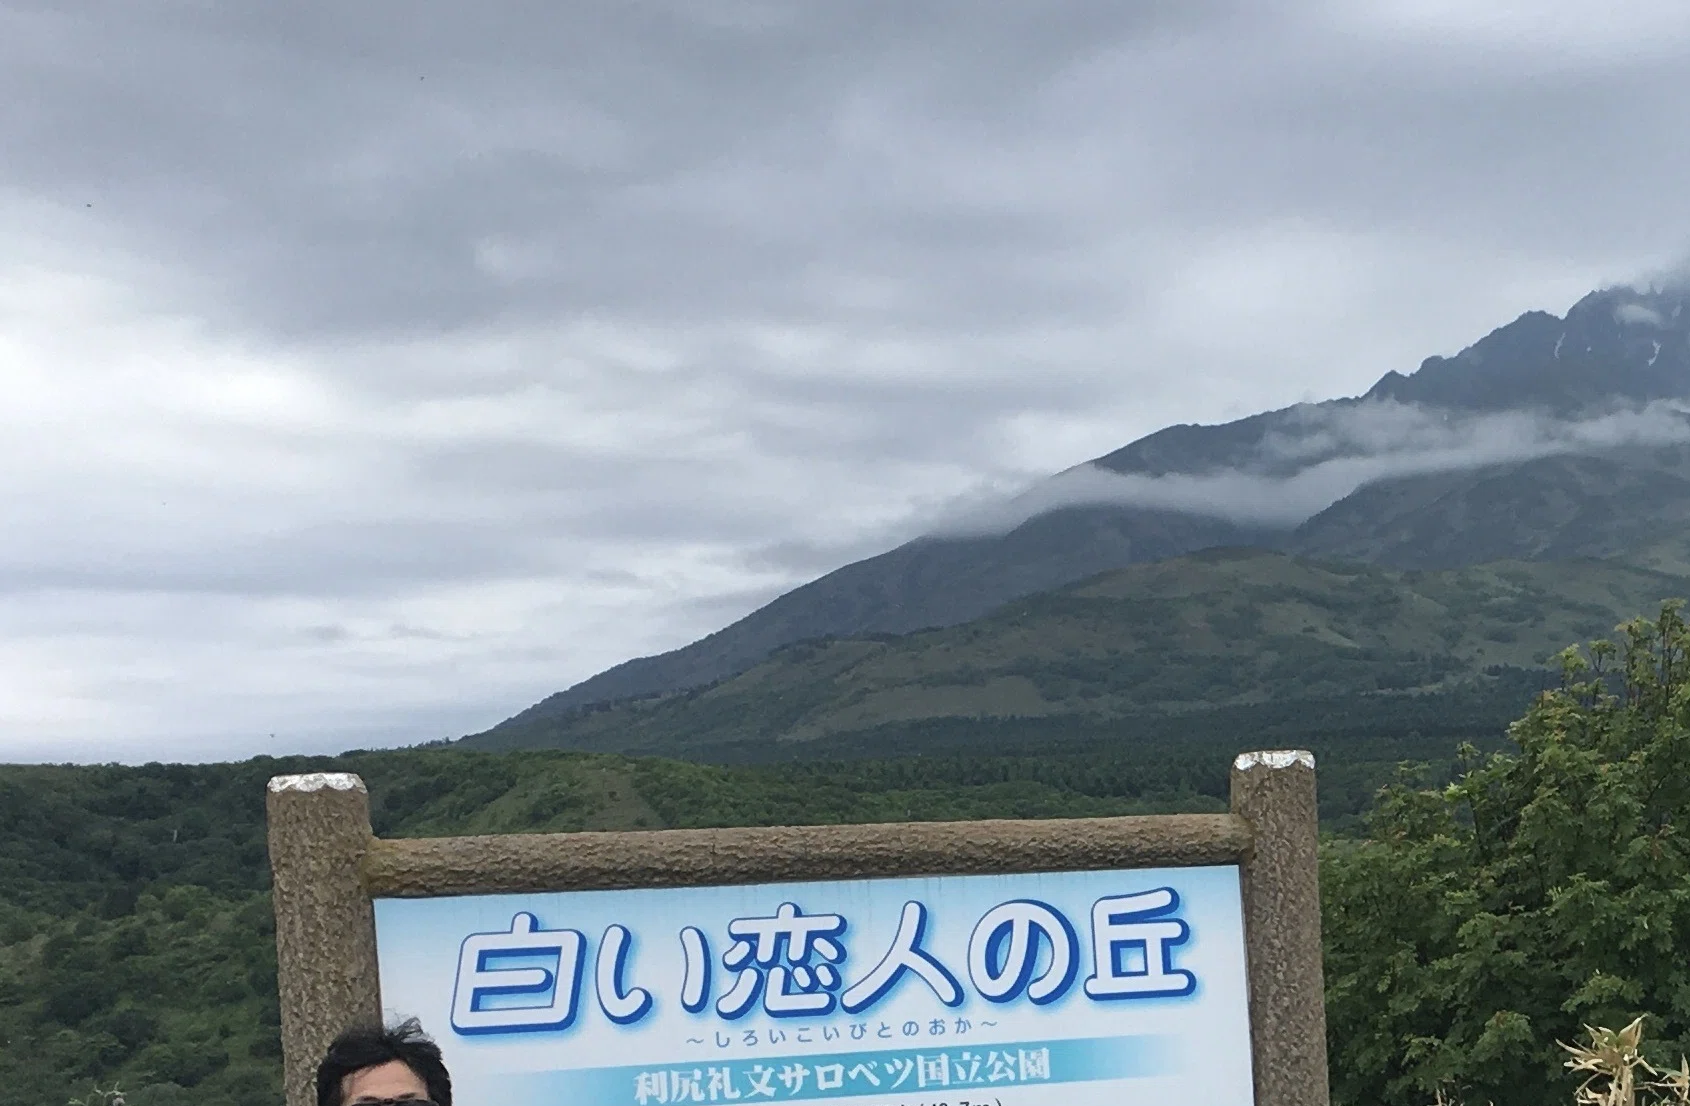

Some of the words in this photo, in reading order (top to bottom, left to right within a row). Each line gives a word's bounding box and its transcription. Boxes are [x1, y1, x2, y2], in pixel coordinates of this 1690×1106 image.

[449, 886, 1199, 1036] 白い恋人の丘
[633, 1046, 1052, 1105] 利尻礼文サロベツ国立公園
